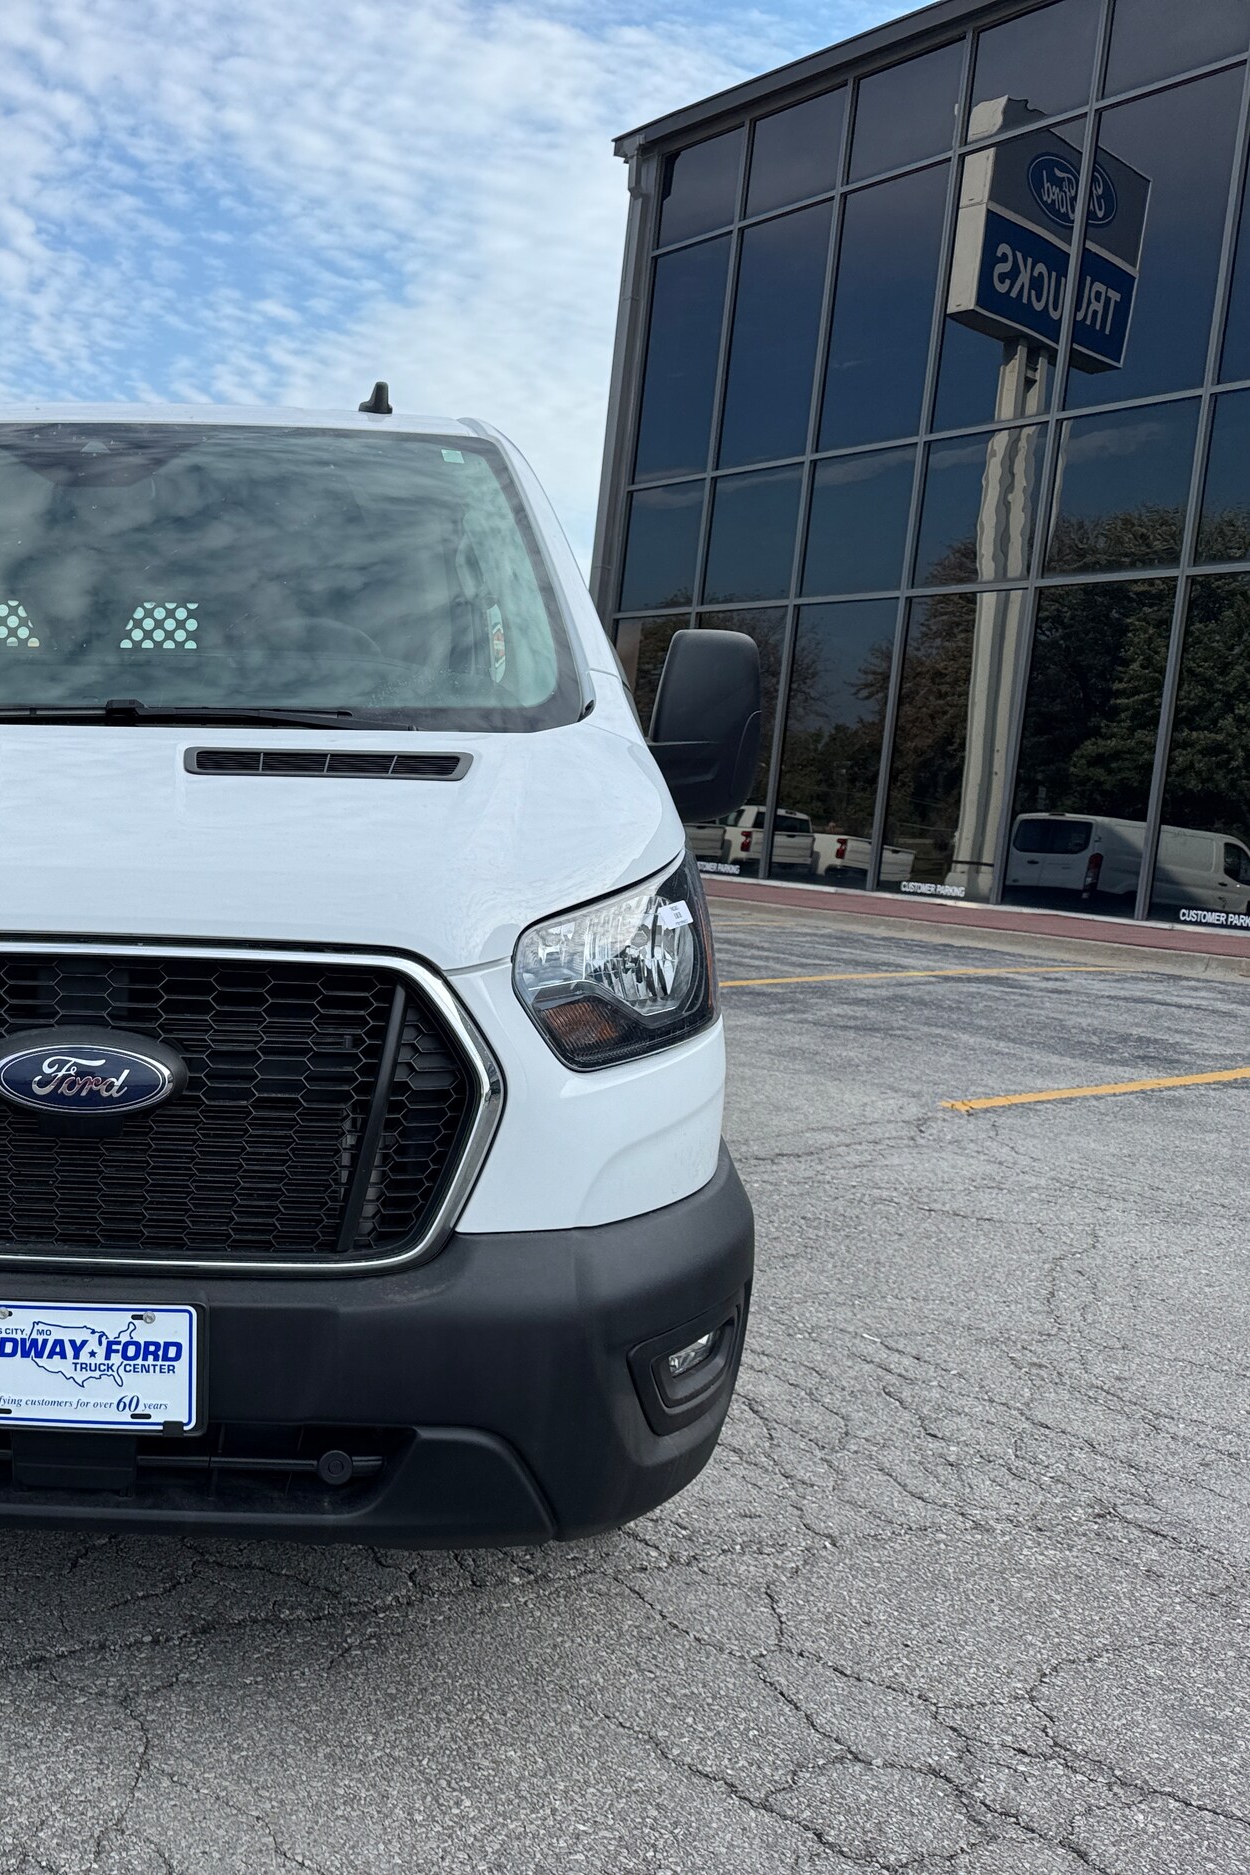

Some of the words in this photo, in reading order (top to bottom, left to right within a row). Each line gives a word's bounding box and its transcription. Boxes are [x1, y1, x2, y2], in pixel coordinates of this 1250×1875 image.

[901, 881, 936, 894] CUSTOMER
[936, 884, 966, 897] PARKING
[1179, 908, 1227, 925] CUSTOMER
[1227, 913, 1250, 927] PARK
[31, 1055, 130, 1098] Ford
[4, 1327, 28, 1336] CITY,
[36, 1328, 52, 1336] MO
[104, 1340, 183, 1362] FORD
[72, 1361, 115, 1373] TRUCK
[123, 1363, 176, 1374] CENTER
[25, 1398, 73, 1408] customers
[74, 1398, 90, 1410] for
[92, 1401, 114, 1409] over
[116, 1394, 140, 1413] 60
[141, 1401, 168, 1412] years
